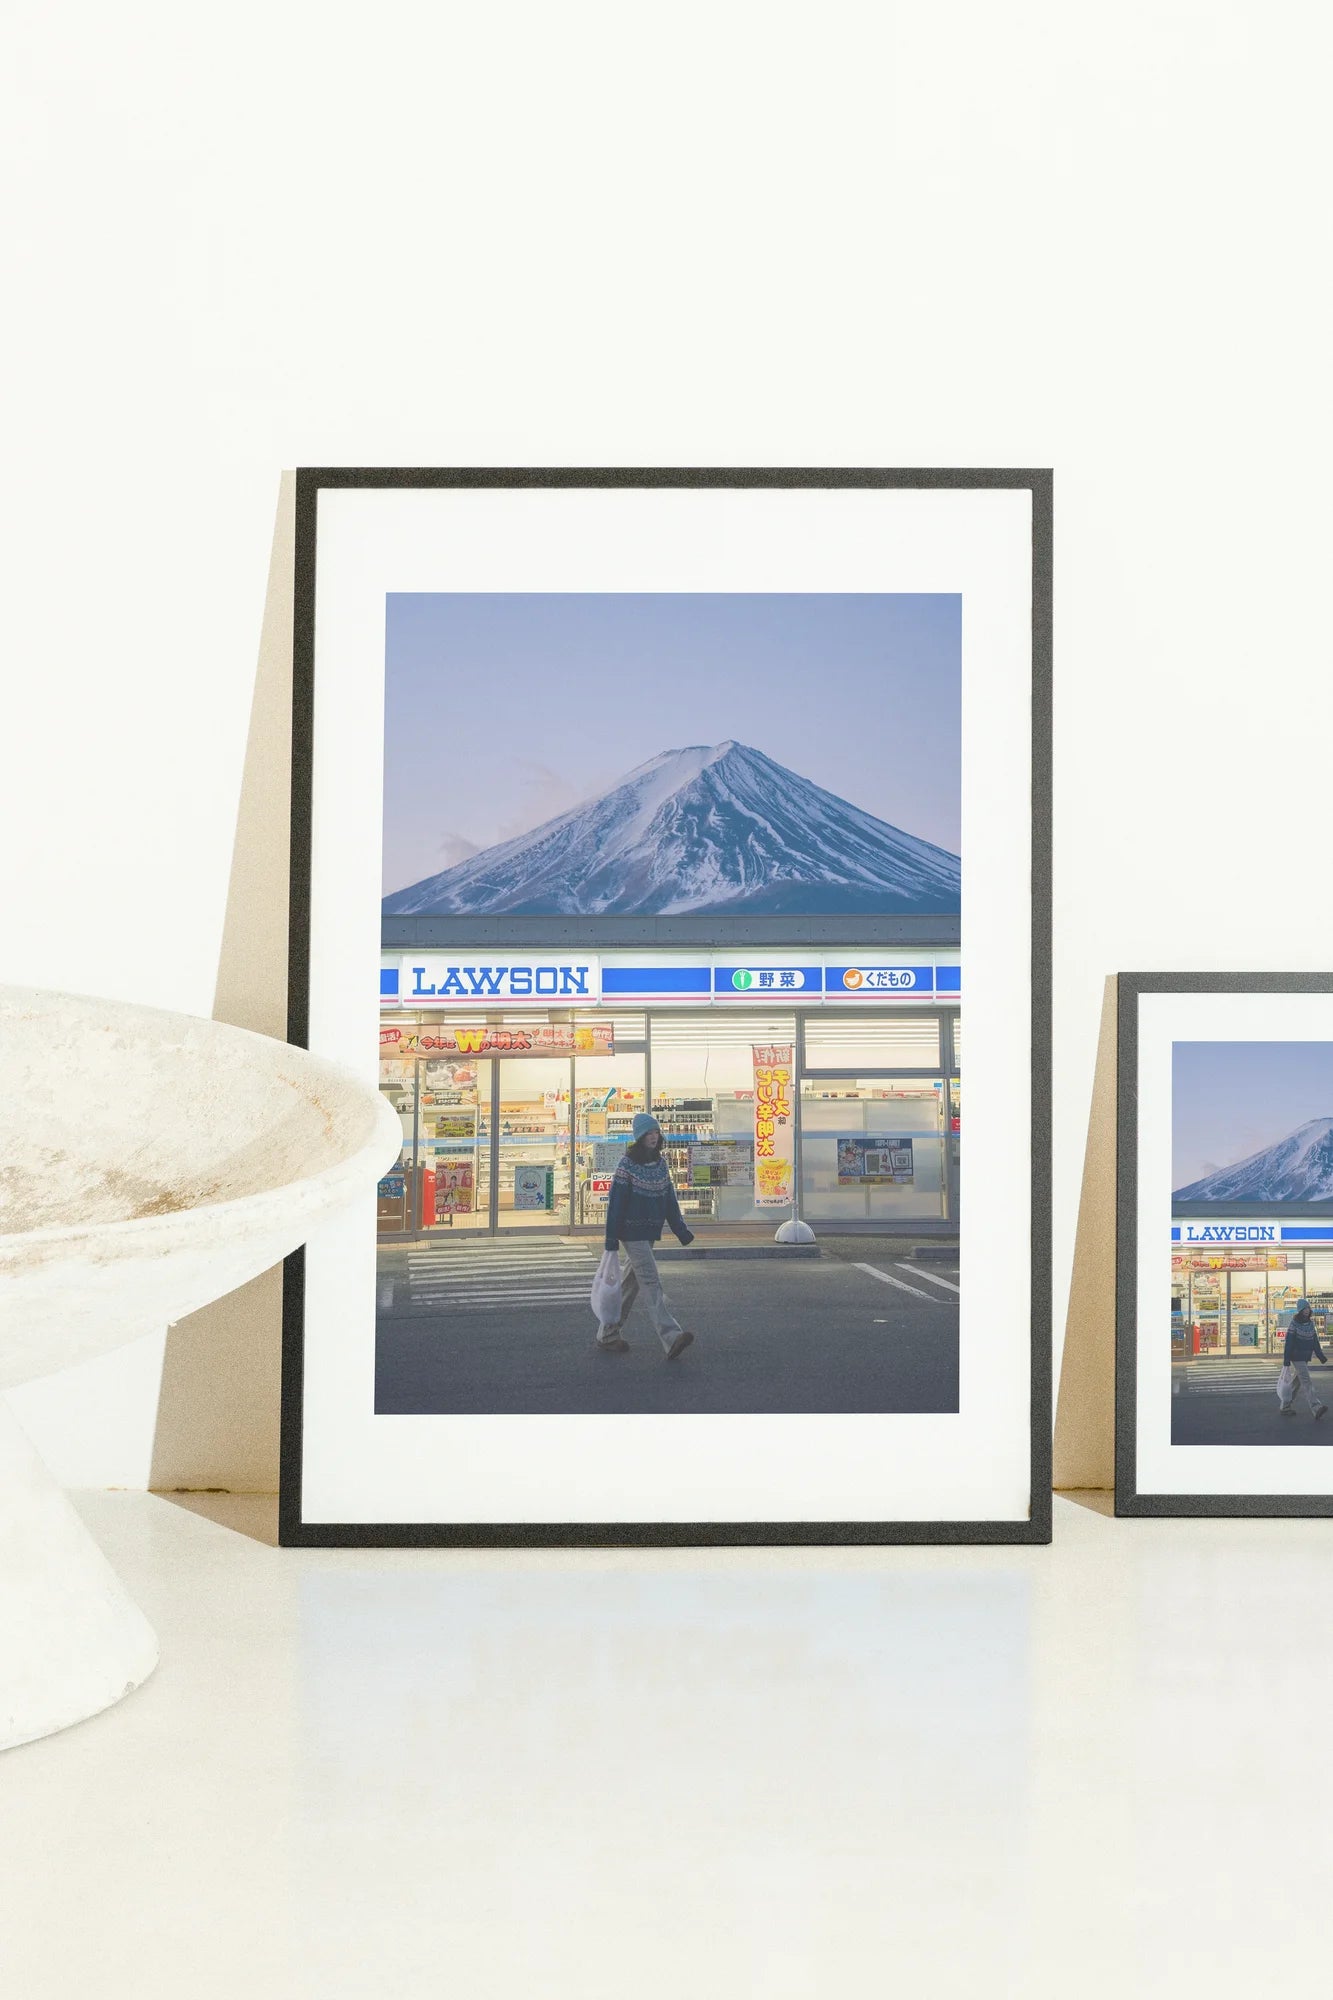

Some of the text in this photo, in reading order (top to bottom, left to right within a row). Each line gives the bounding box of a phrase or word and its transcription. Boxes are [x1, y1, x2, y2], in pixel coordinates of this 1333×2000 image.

[412, 967, 589, 995] LAWSON
[759, 972, 795, 987] 野菜
[866, 972, 911, 986] くだもの
[598, 1182, 612, 1190] AT
[1187, 1226, 1275, 1240] LAWSON
